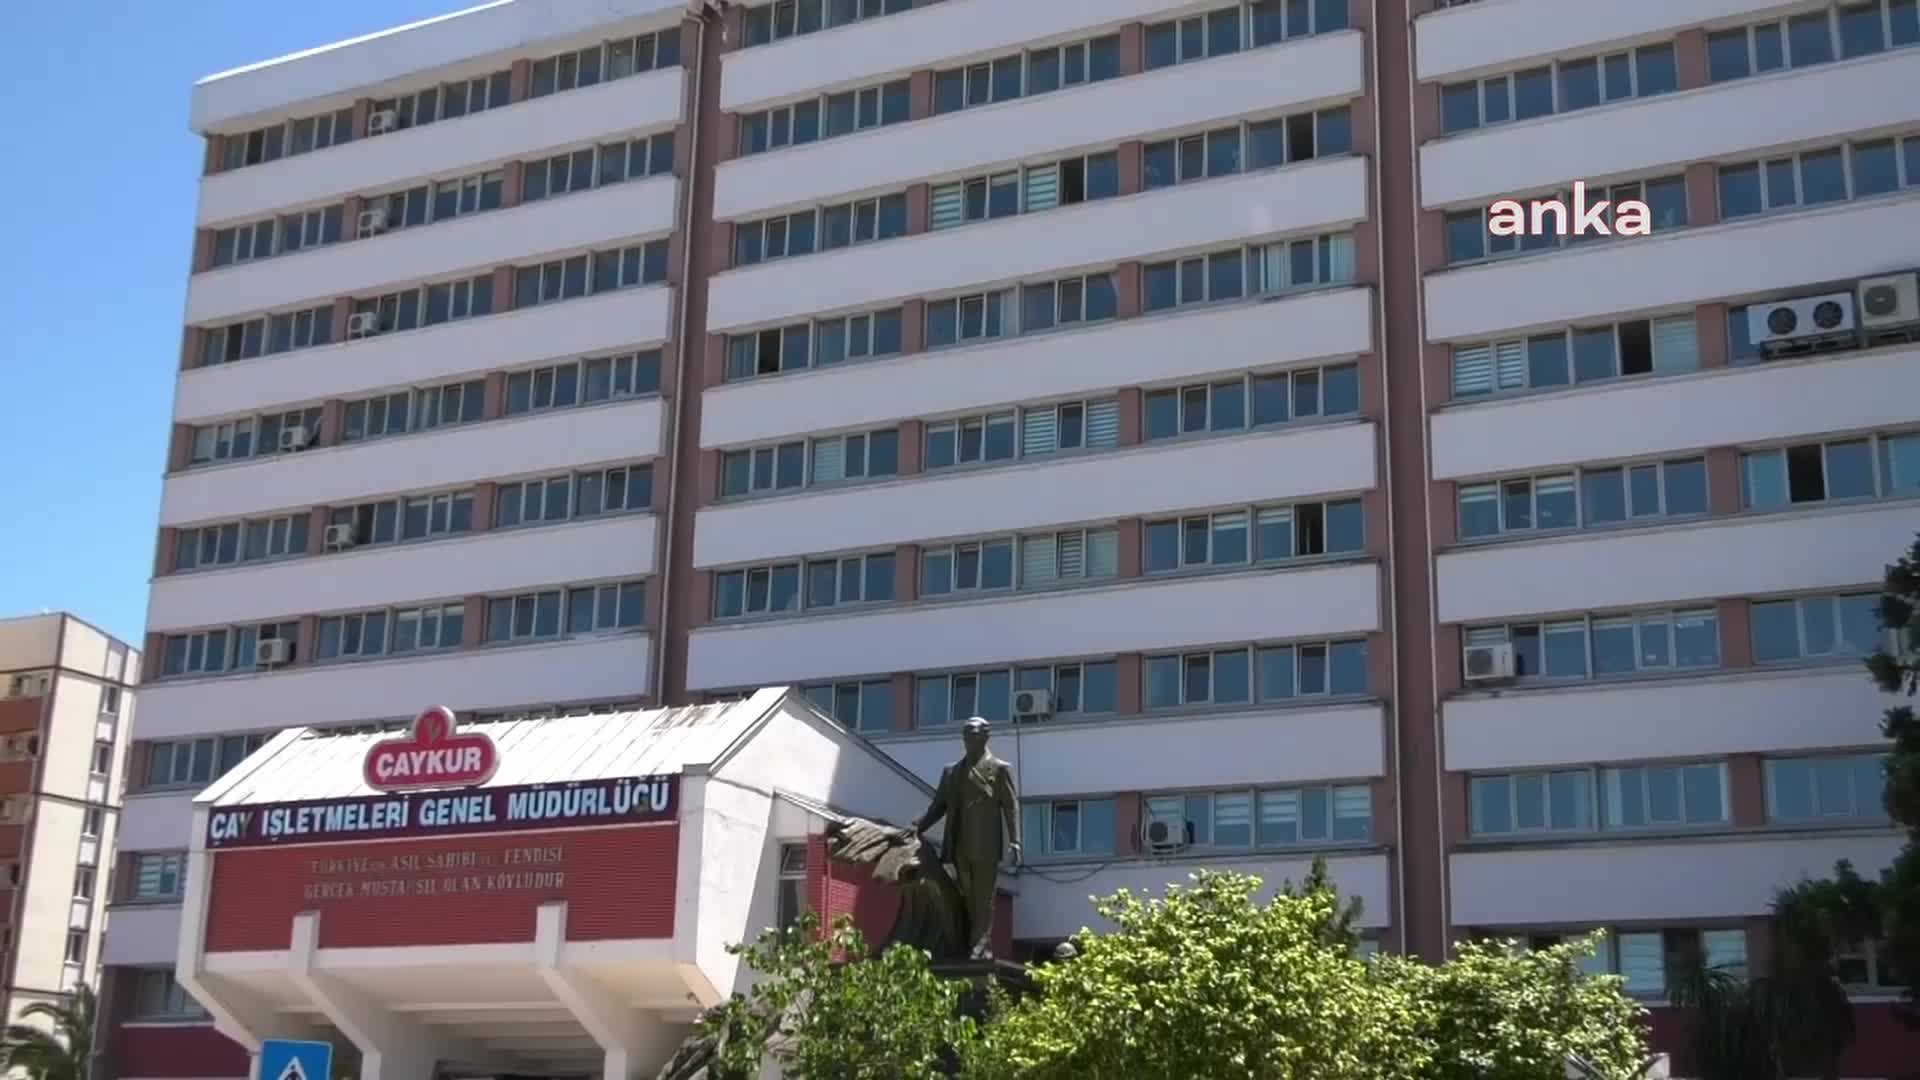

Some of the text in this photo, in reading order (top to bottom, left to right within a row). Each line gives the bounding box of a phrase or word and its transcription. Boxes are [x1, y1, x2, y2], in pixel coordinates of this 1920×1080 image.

[375, 746, 482, 782] ÇAYKUR
[210, 811, 254, 846] ÇAY
[418, 795, 497, 827] GENEL
